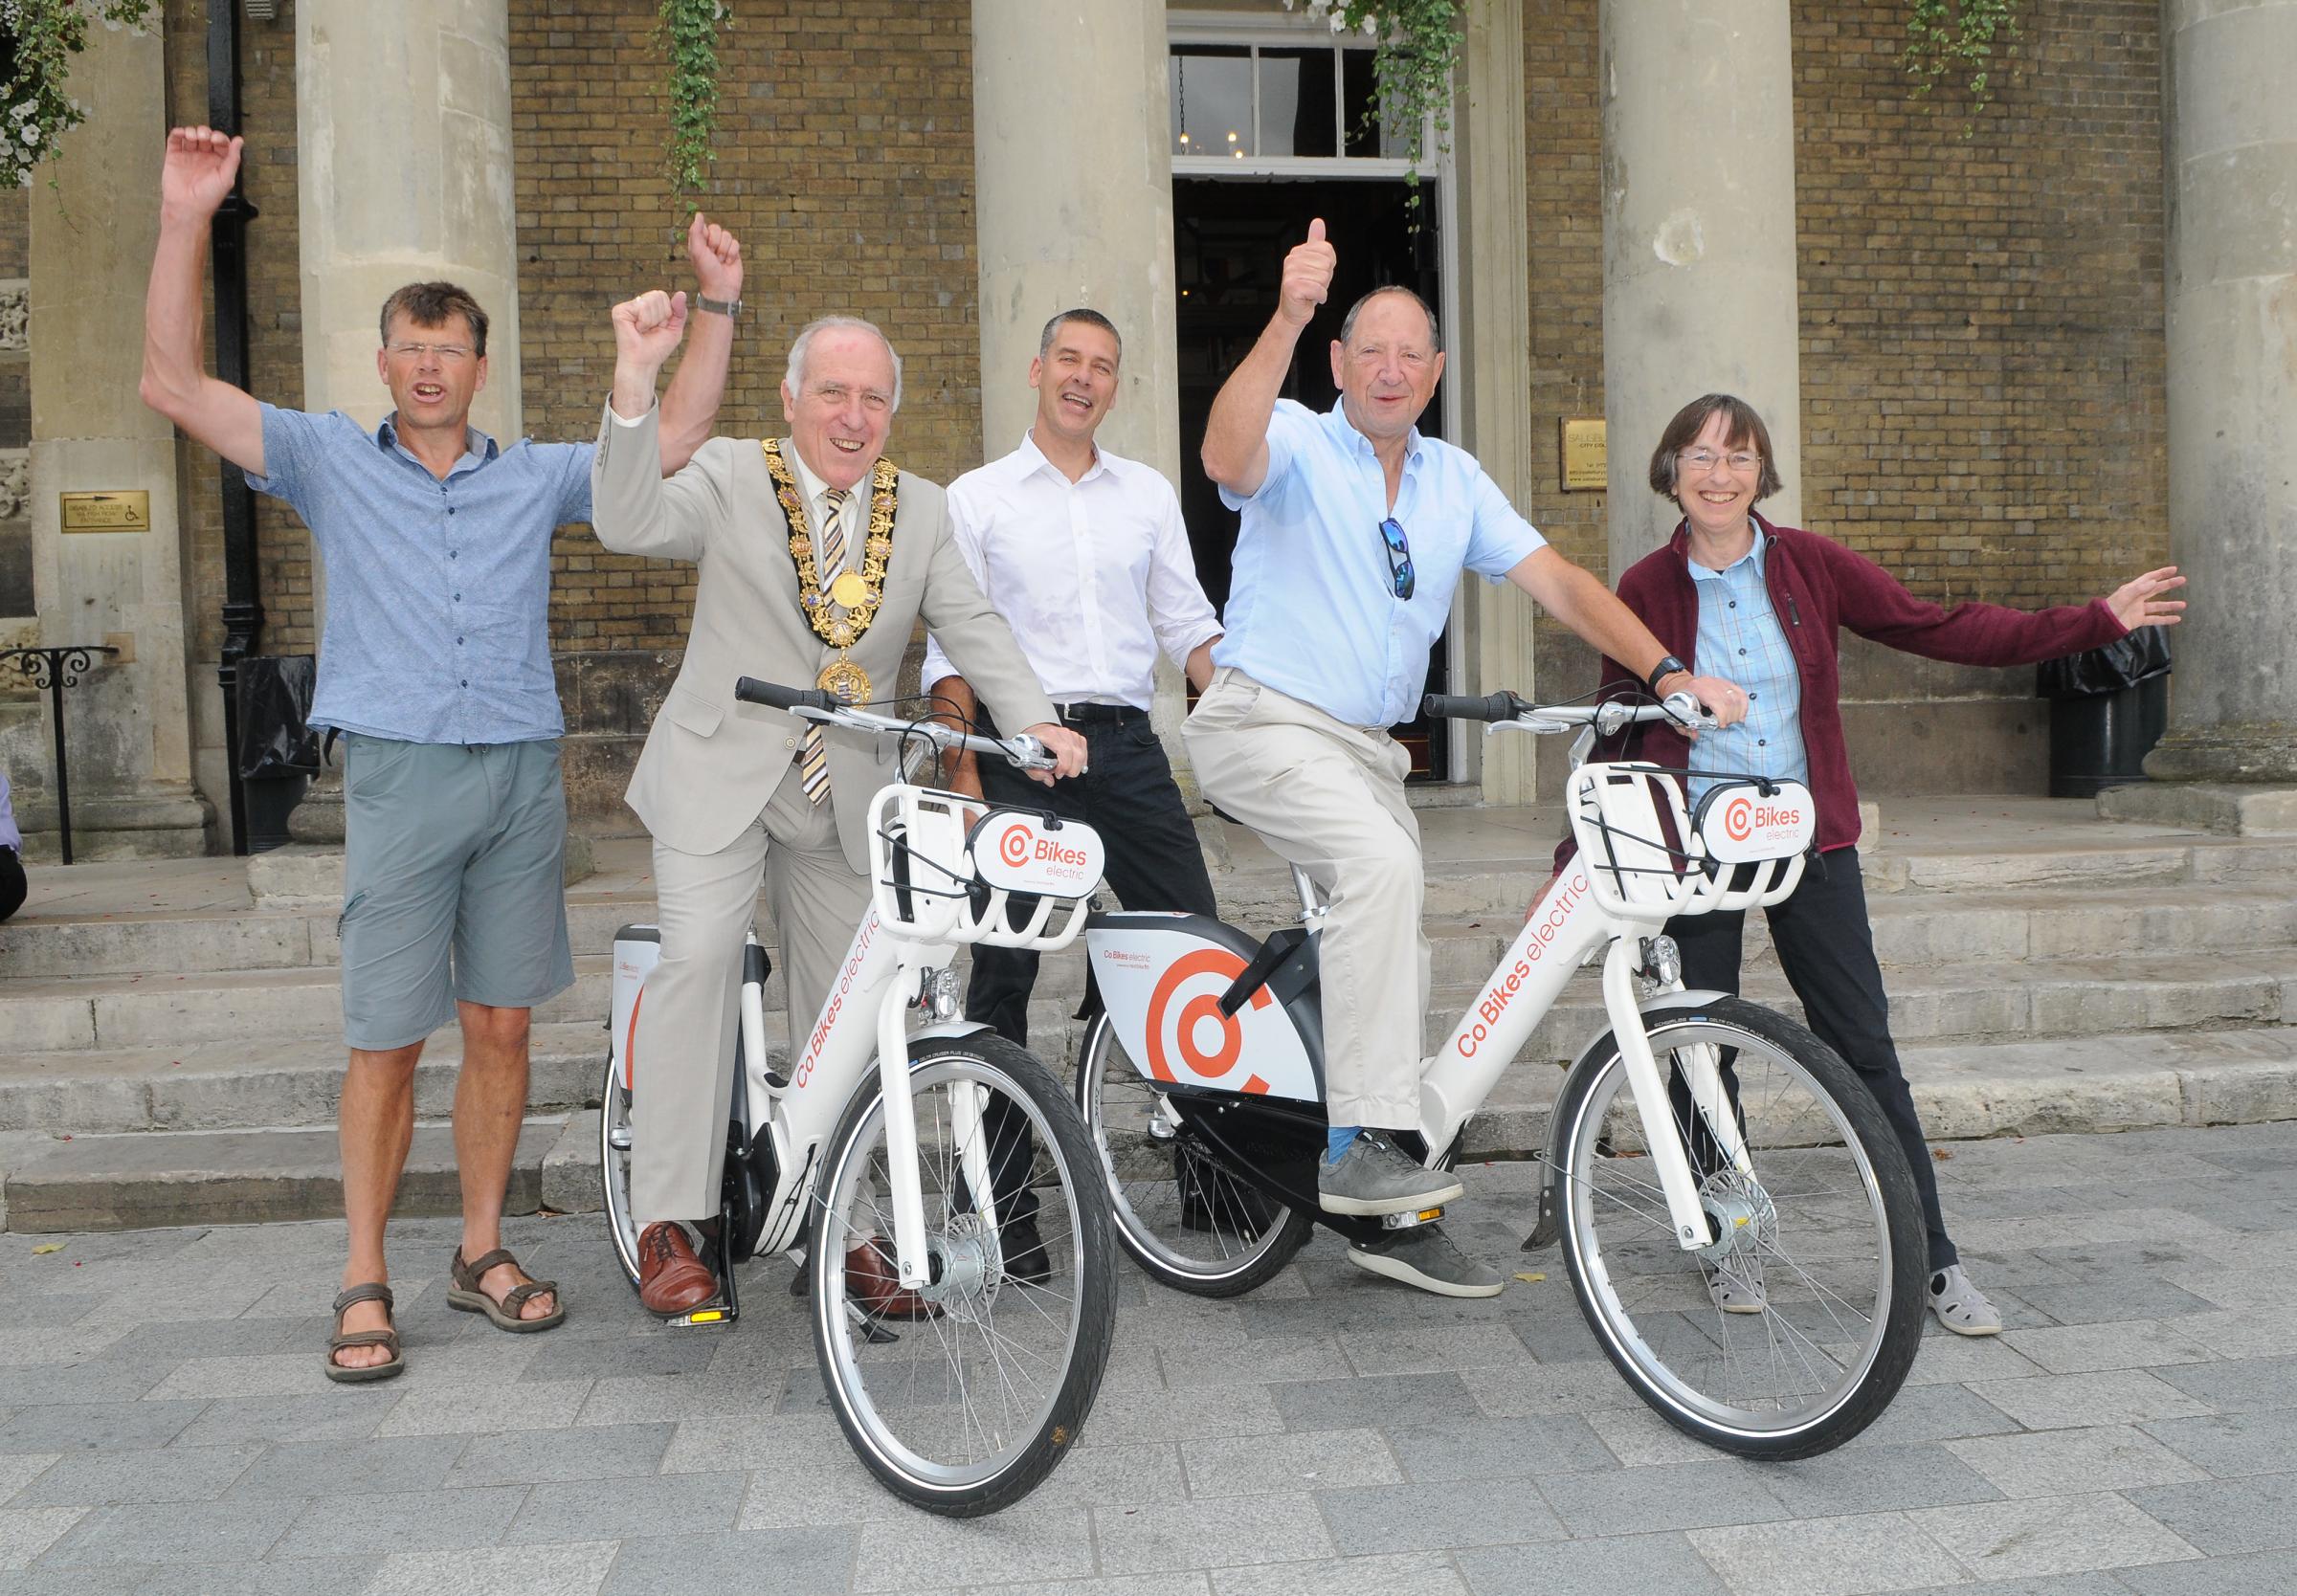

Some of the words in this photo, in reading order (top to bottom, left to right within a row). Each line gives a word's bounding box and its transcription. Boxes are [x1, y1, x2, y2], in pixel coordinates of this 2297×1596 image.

[1754, 807, 1799, 829] Bikes
[1766, 829, 1799, 841] electric
[1035, 839, 1087, 866] Bikes
[1046, 865, 1084, 880] electric
[1104, 949, 1113, 959] Co
[1113, 950, 1128, 961] Bikes
[1128, 952, 1150, 963] electric
[1458, 1023, 1487, 1058] Co
[1479, 960, 1530, 1027] Bikes
[1527, 875, 1589, 962] electric
[796, 1054, 814, 1088] Co
[811, 993, 842, 1057] Bikes
[840, 910, 880, 995] electric
